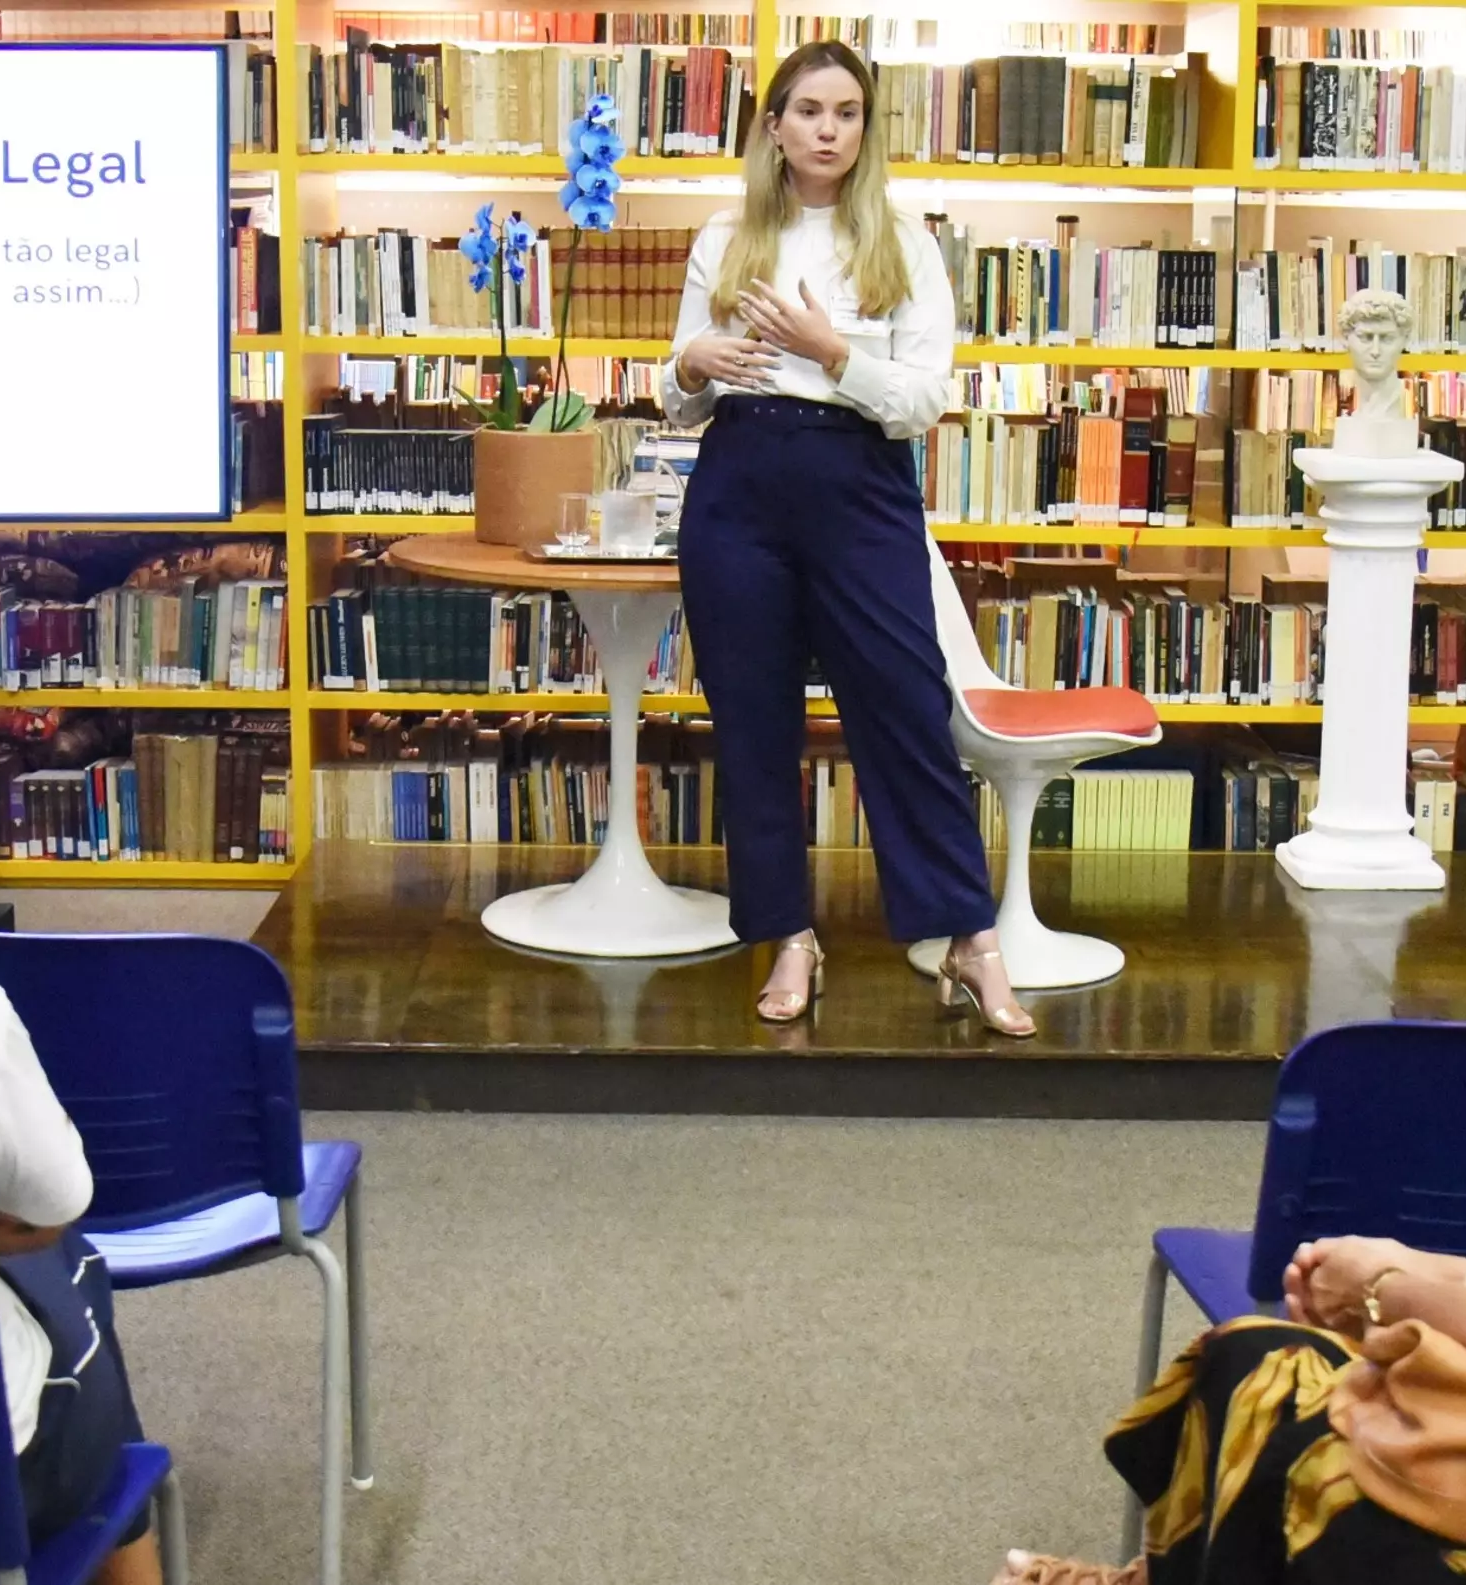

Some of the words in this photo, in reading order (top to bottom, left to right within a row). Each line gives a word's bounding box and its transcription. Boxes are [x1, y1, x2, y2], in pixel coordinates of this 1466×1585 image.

[2, 139, 147, 200] Legal
[2, 237, 54, 263] tão
[65, 237, 141, 271] legal
